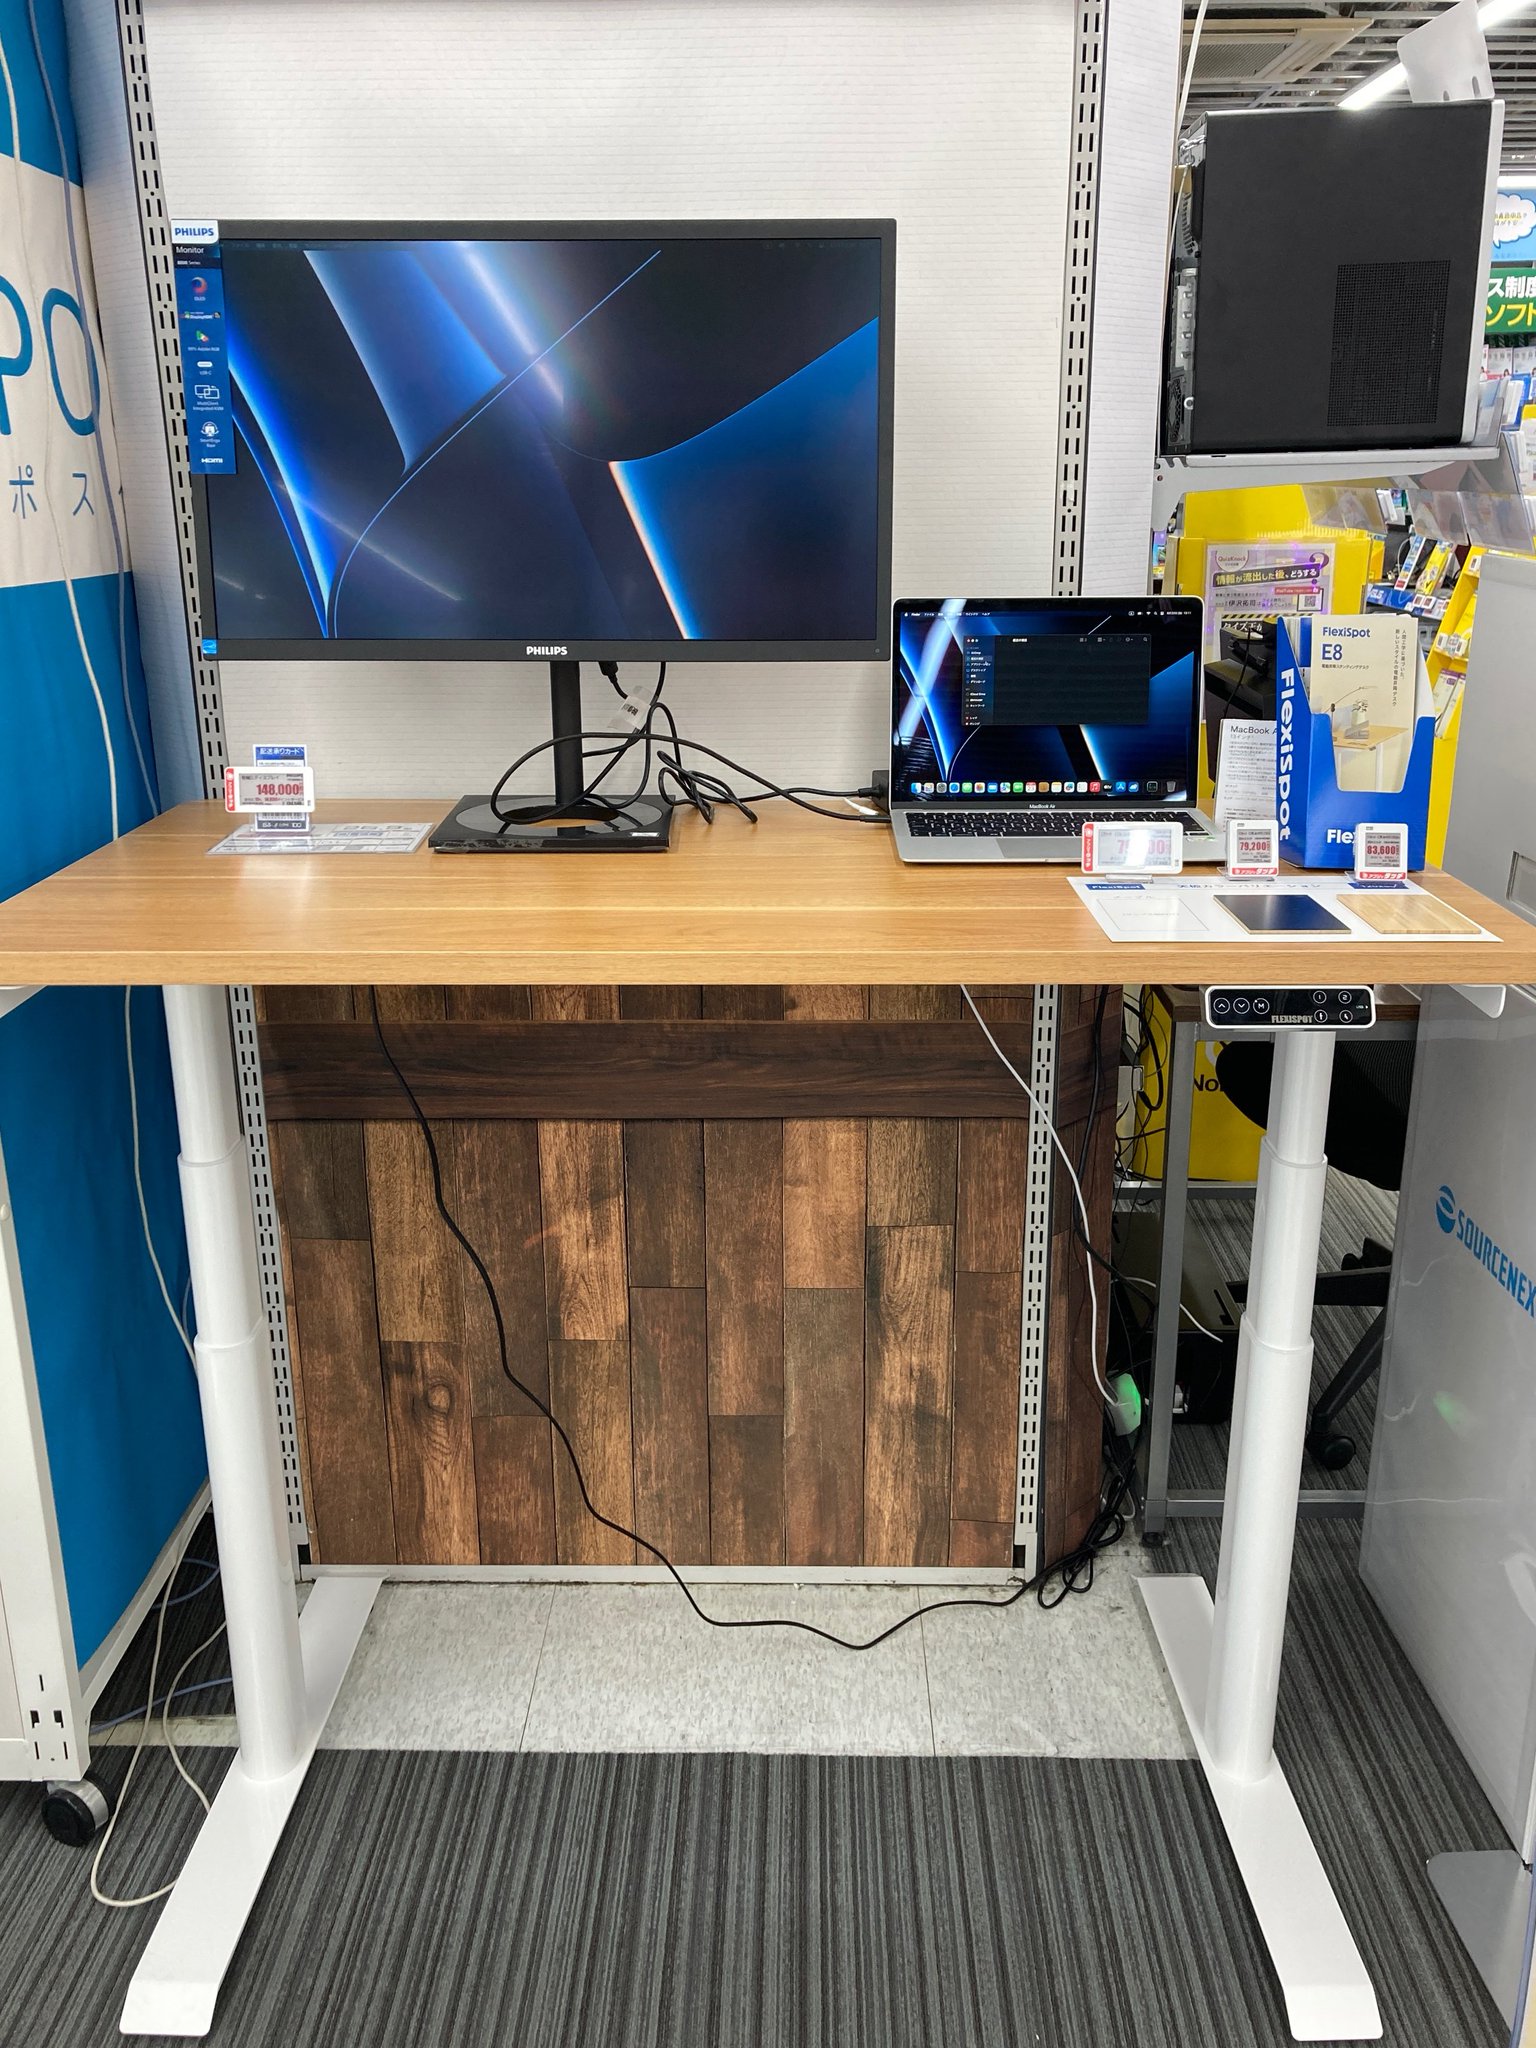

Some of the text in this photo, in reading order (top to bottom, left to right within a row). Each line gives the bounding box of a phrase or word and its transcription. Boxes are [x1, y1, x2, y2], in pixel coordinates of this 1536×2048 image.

[174, 227, 215, 237] PHILIPS
[175, 246, 205, 254] Monitor
[1322, 627, 1371, 639] FlexiSpot
[526, 646, 568, 656] PHILIPS
[1322, 643, 1343, 661] E8
[1230, 725, 1270, 735] MacBook
[1278, 667, 1295, 842] FlexiSpot
[256, 783, 300, 796] 148,000
[1326, 829, 1355, 844] Fle
[1239, 841, 1268, 852] 79,200
[1367, 845, 1396, 856] 83,600
[1271, 1015, 1313, 1024] FLEXISPOT
[1194, 1074, 1225, 1093] No
